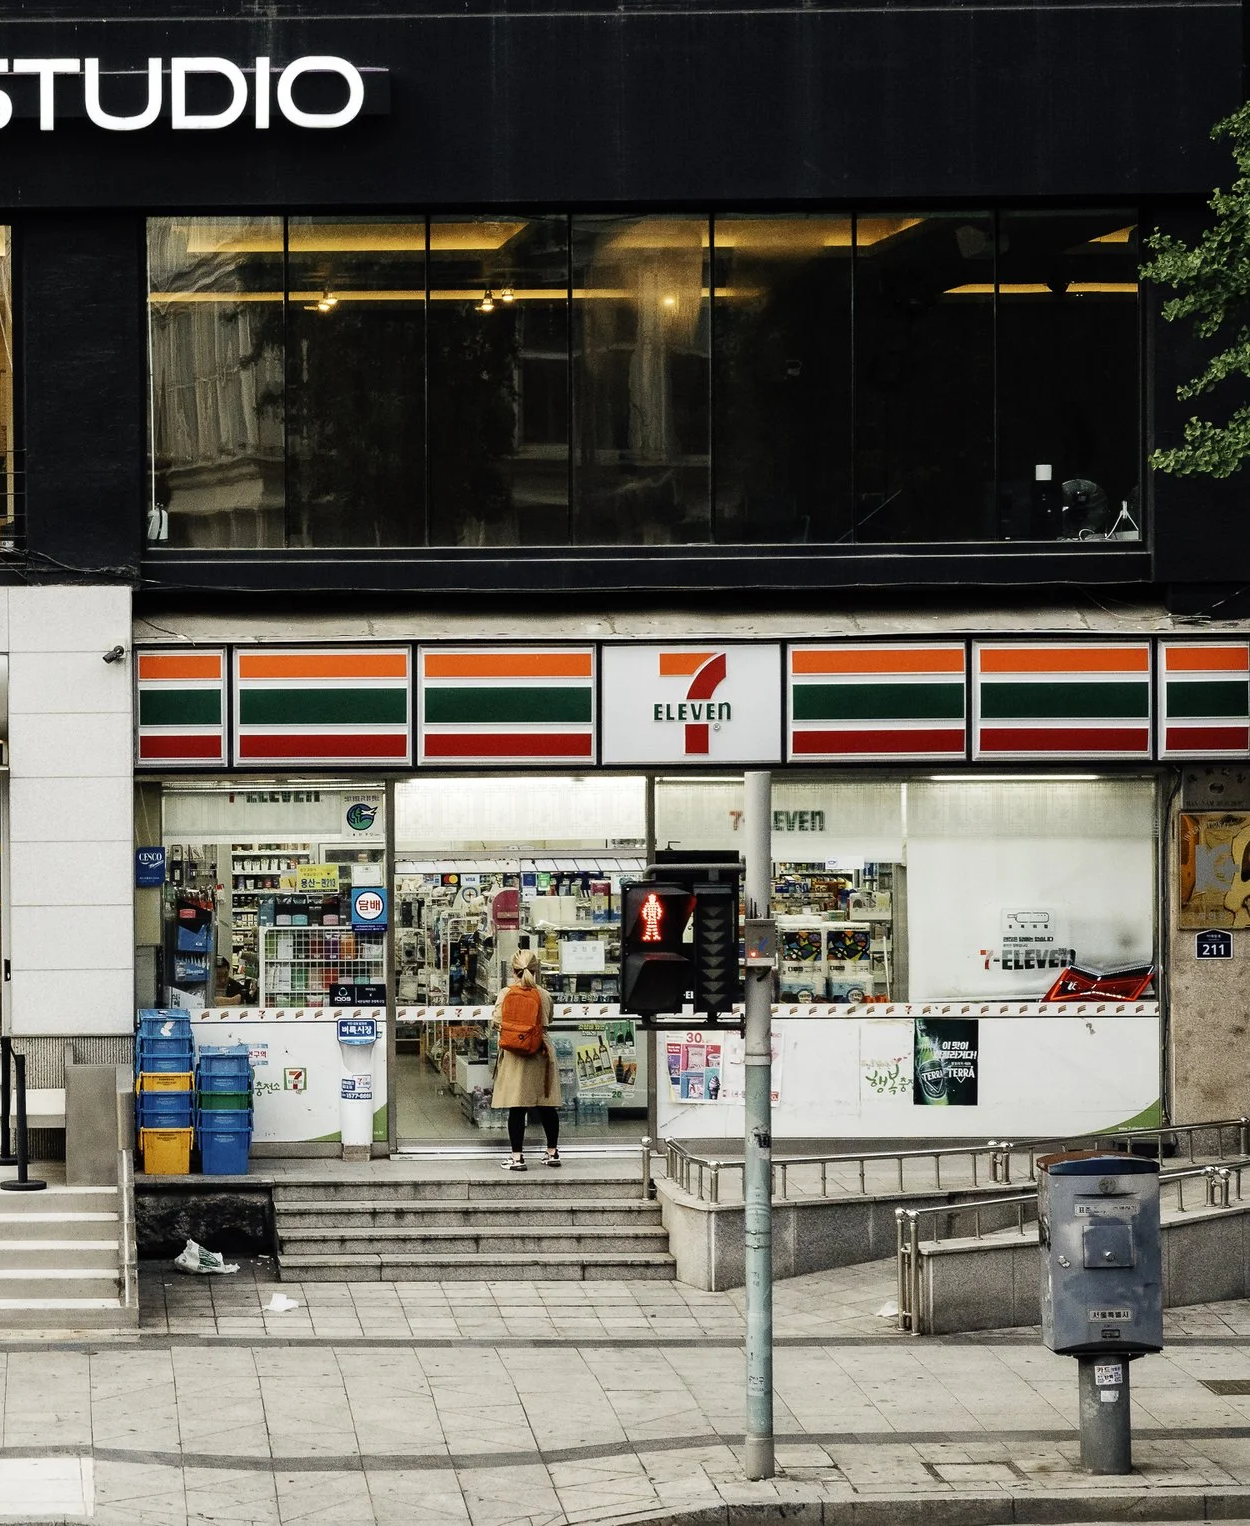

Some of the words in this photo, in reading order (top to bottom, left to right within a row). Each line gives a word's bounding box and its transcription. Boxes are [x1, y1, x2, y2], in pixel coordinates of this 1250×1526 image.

[659, 653, 727, 754] 7
[138, 852, 163, 862] CESCO
[358, 899, 381, 911] 담배
[1202, 944, 1225, 955] 211
[686, 1032, 702, 1044] 30
[942, 1042, 950, 1050] 이
[951, 1041, 969, 1050] 맛이
[254, 1081, 281, 1097] 충전소
[1092, 1311, 1130, 1319] 서울특별시
